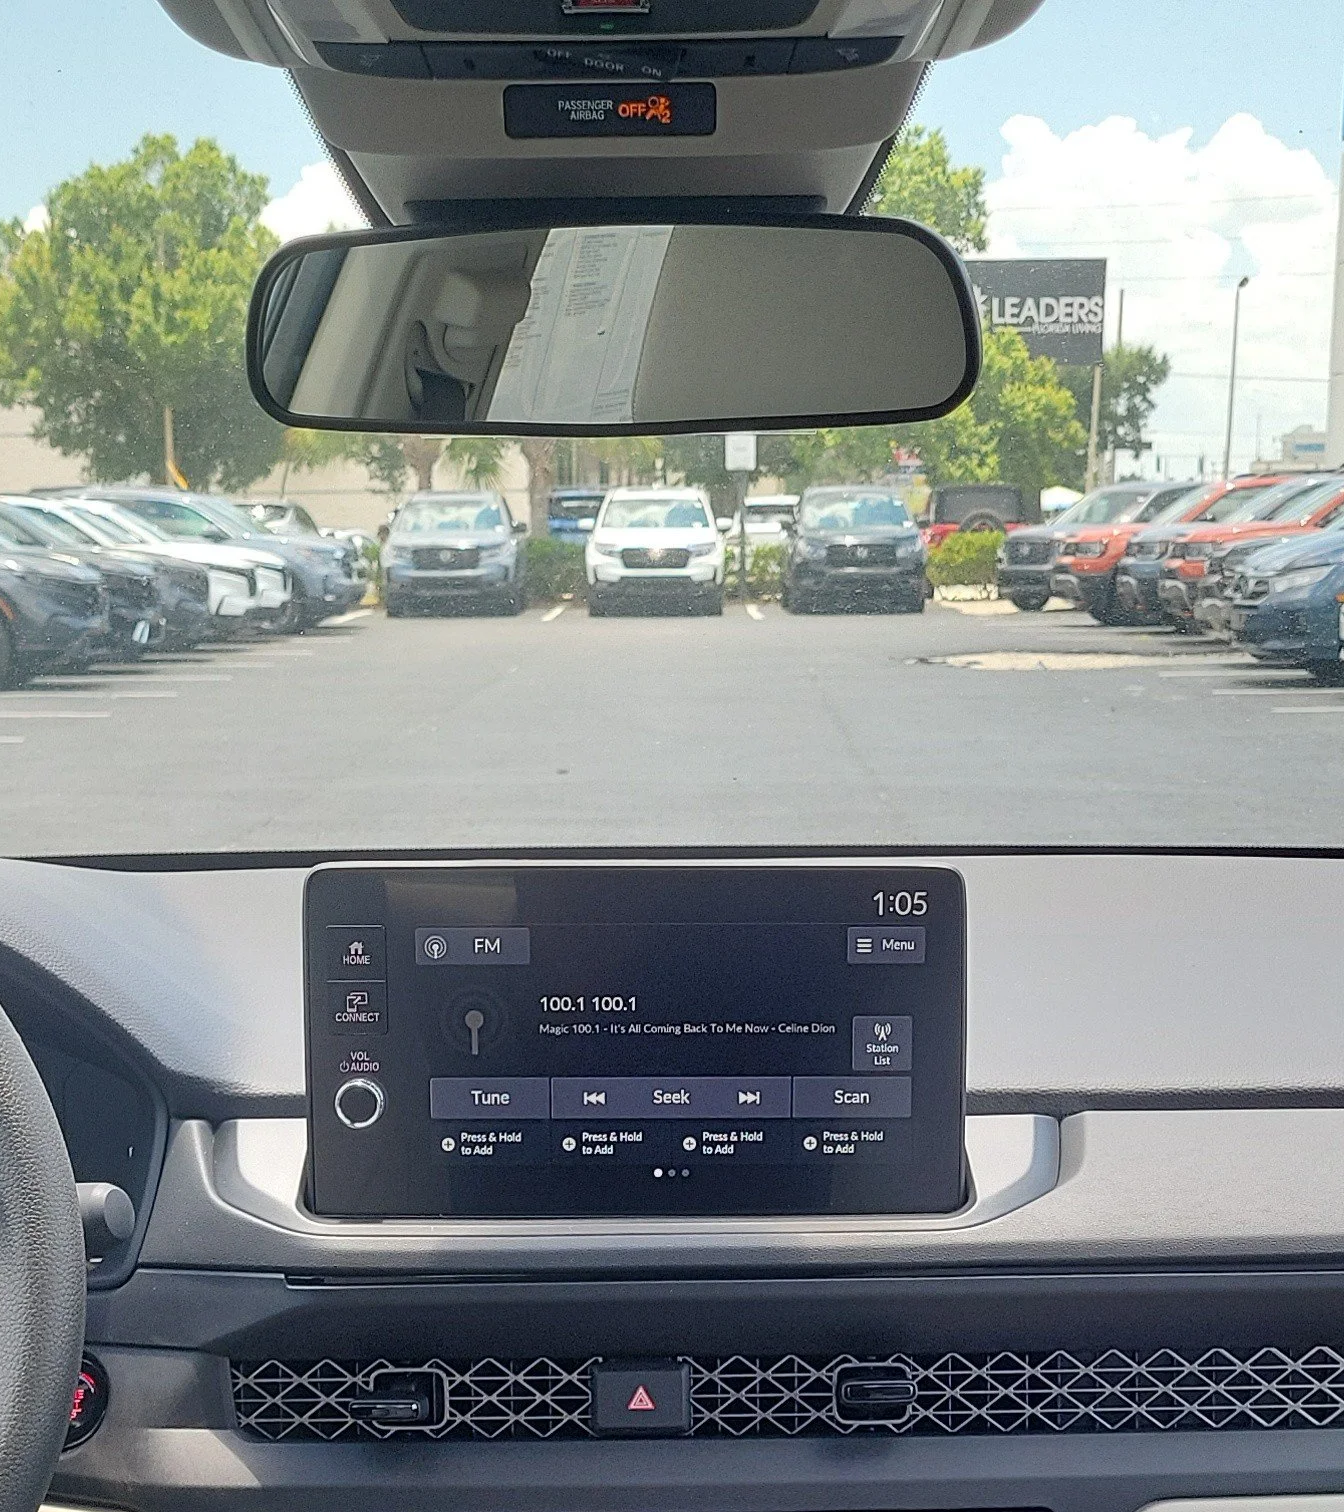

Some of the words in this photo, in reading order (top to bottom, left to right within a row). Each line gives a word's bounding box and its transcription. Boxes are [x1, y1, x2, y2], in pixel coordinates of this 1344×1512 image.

[584, 57, 624, 72] DOOR
[641, 65, 662, 77] ON
[558, 100, 613, 111] PASSENGER
[618, 103, 646, 118] OFF
[570, 110, 604, 121] AIRBAG
[991, 296, 1104, 324] LEADERS
[873, 891, 928, 916] 1:05
[474, 938, 500, 953] FM
[882, 939, 915, 951] Menu
[343, 955, 371, 965] HOME
[540, 996, 584, 1011] 100.1
[592, 996, 636, 1011] 100.1
[335, 1013, 379, 1022] CONNECT
[539, 1024, 569, 1035] Magic
[573, 1024, 600, 1034] 100.1
[610, 1024, 626, 1034] It's
[628, 1024, 641, 1034] All
[643, 1024, 681, 1035] Coming
[683, 1023, 707, 1034] Back
[710, 1023, 723, 1034] To
[726, 1023, 742, 1034] Me
[745, 1023, 769, 1034] Now
[778, 1023, 809, 1033] Celine
[811, 1023, 835, 1033] Dion
[866, 1043, 899, 1053] Station
[350, 1051, 370, 1061] VOL
[874, 1056, 890, 1066] List
[350, 1062, 379, 1072] AUDIO
[471, 1090, 510, 1105] Tune
[653, 1089, 690, 1104] Seek
[834, 1090, 870, 1104] Scan
[461, 1132, 487, 1143] Press
[488, 1132, 497, 1143] &
[499, 1132, 522, 1143] Hold
[582, 1132, 607, 1143] Press
[609, 1132, 618, 1143] &
[620, 1132, 642, 1143] Hold
[702, 1131, 728, 1142] Press
[730, 1131, 738, 1142] &
[740, 1131, 763, 1142] Hold
[823, 1131, 848, 1142] Press
[850, 1131, 859, 1142] &
[861, 1131, 884, 1142] Hold
[461, 1145, 471, 1155] to
[473, 1145, 493, 1155] Add
[582, 1145, 592, 1155] to
[594, 1145, 613, 1155] Add
[702, 1144, 713, 1154] to
[715, 1144, 734, 1154] Add
[823, 1144, 833, 1154] to
[835, 1144, 854, 1154] Add
